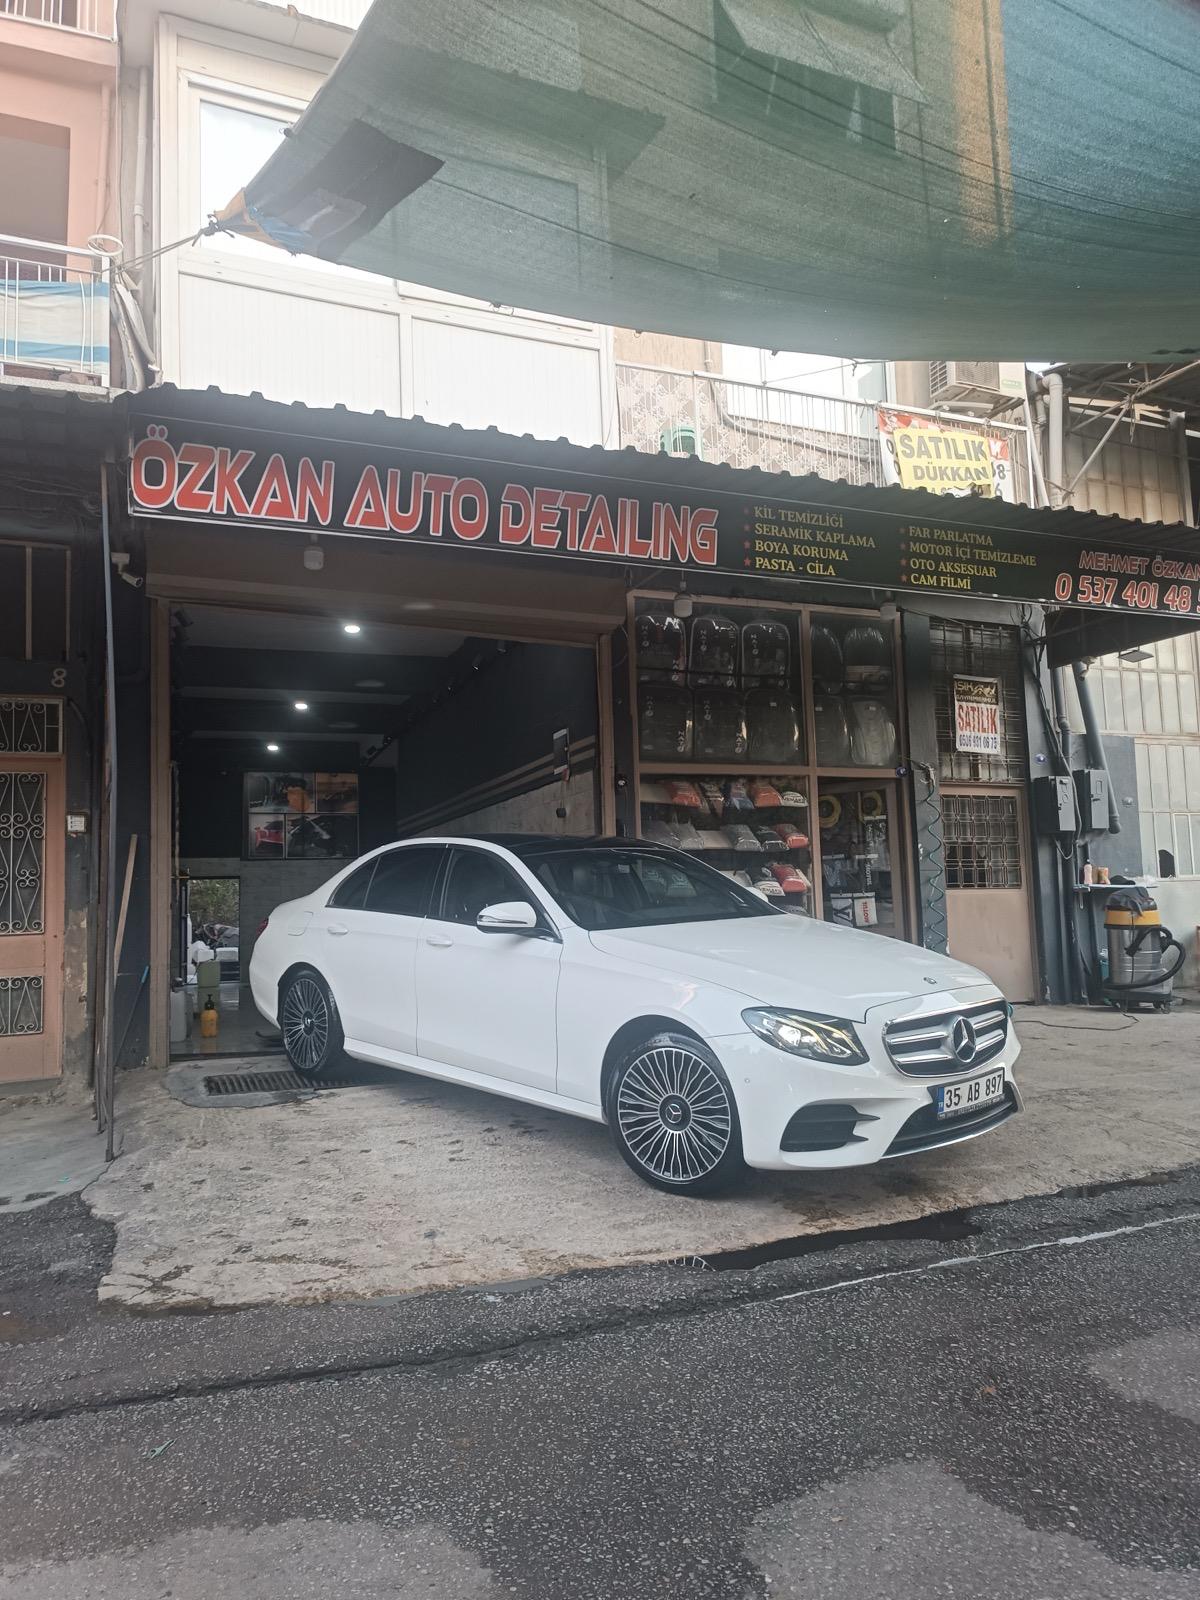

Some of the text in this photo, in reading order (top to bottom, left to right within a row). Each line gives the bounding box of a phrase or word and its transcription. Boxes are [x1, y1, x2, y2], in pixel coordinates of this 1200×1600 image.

[899, 433, 988, 462] SATILIK
[912, 461, 989, 482] DÜKKAN
[131, 424, 719, 566] ÖZKAN AUTO DETAILING
[754, 505, 776, 519] KİL
[754, 522, 876, 548] SERAMİK KAPLAMA
[909, 526, 993, 546] FAR PARLATMA
[755, 540, 848, 561] BOYA KORUMA
[909, 541, 953, 557] MOTOR
[973, 549, 1037, 566] TEMİZLEME
[755, 557, 795, 572] PASTA
[806, 560, 836, 576] CİLA
[910, 558, 997, 578] OTO AKSESUAR
[1079, 550, 1150, 576] MEHMET
[910, 573, 972, 590] CAM FİLMİ
[1055, 572, 1073, 601] 0
[1077, 575, 1119, 608] 537
[1122, 580, 1159, 609] 401
[1164, 584, 1192, 613] 48
[51, 668, 67, 688] 8
[957, 704, 998, 734] SATILIK
[945, 1087, 961, 1109] 35
[967, 1082, 980, 1103] AB
[985, 1074, 1002, 1096] 897
